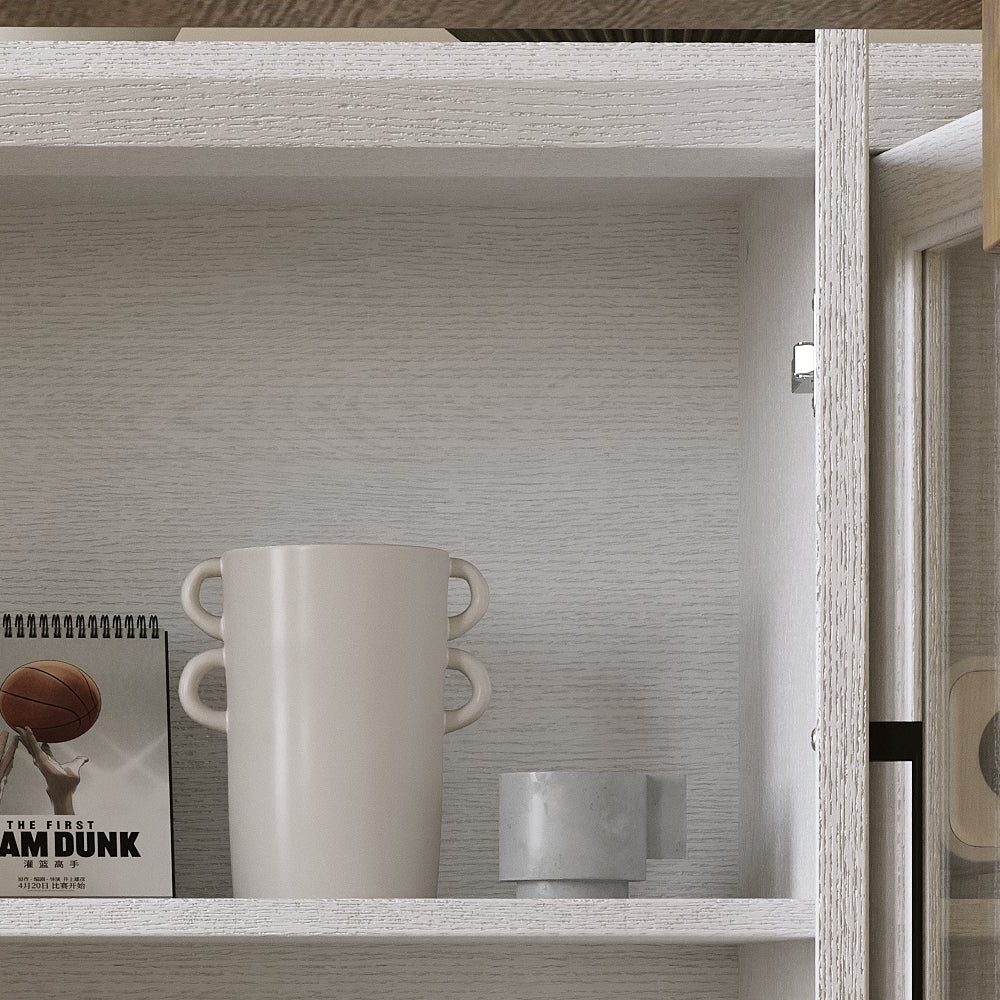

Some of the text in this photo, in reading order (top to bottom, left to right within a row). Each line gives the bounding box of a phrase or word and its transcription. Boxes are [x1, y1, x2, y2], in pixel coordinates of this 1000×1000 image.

[6, 820, 95, 830] THE FIRST
[54, 831, 142, 858] DUNK
